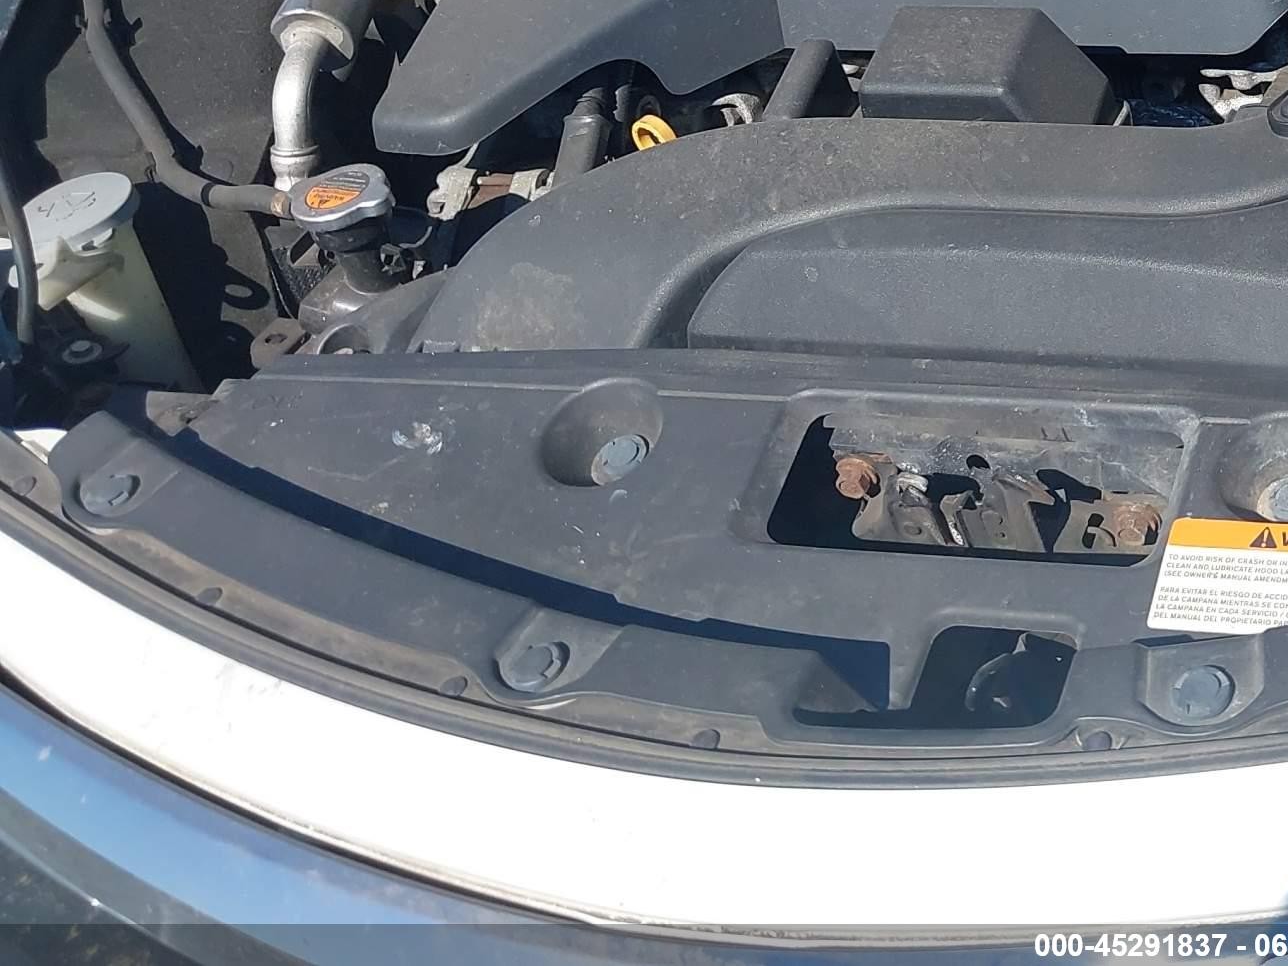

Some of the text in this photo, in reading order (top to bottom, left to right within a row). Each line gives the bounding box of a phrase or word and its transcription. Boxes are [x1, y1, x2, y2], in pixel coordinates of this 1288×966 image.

[1238, 557, 1264, 565] CRASH
[1211, 564, 1253, 573] LUBRICATE
[1220, 574, 1251, 582] MANUAL
[1160, 586, 1180, 594] PARA
[1220, 590, 1250, 598] RIESGO
[1181, 596, 1218, 605] CAMPANA
[1220, 599, 1260, 608] MIENTRAS
[1167, 604, 1204, 613] CAMPANA
[1241, 608, 1278, 618] SERVICIO
[1153, 611, 1168, 619] DEL
[1170, 612, 1201, 622] MANUAL
[1220, 616, 1271, 626] PROPIETARIO
